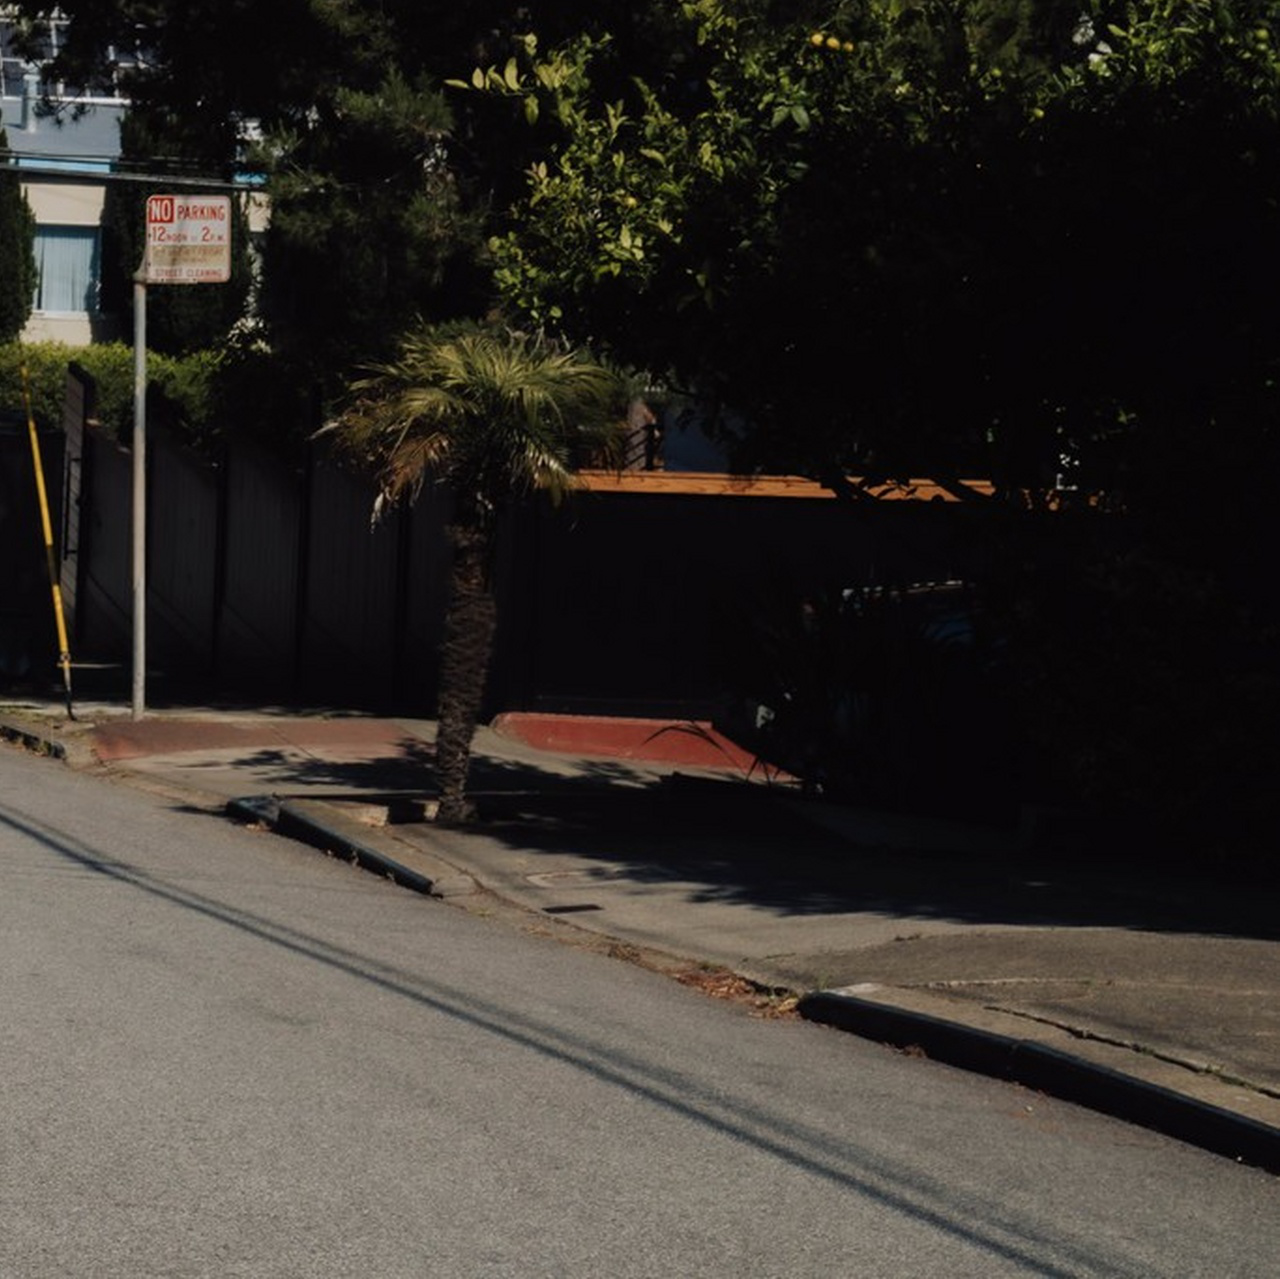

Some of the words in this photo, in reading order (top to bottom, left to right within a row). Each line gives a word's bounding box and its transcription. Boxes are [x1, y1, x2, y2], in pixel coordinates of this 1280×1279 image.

[150, 199, 172, 221] NO
[177, 205, 225, 221] PARKING
[186, 269, 222, 277] CLEANING
